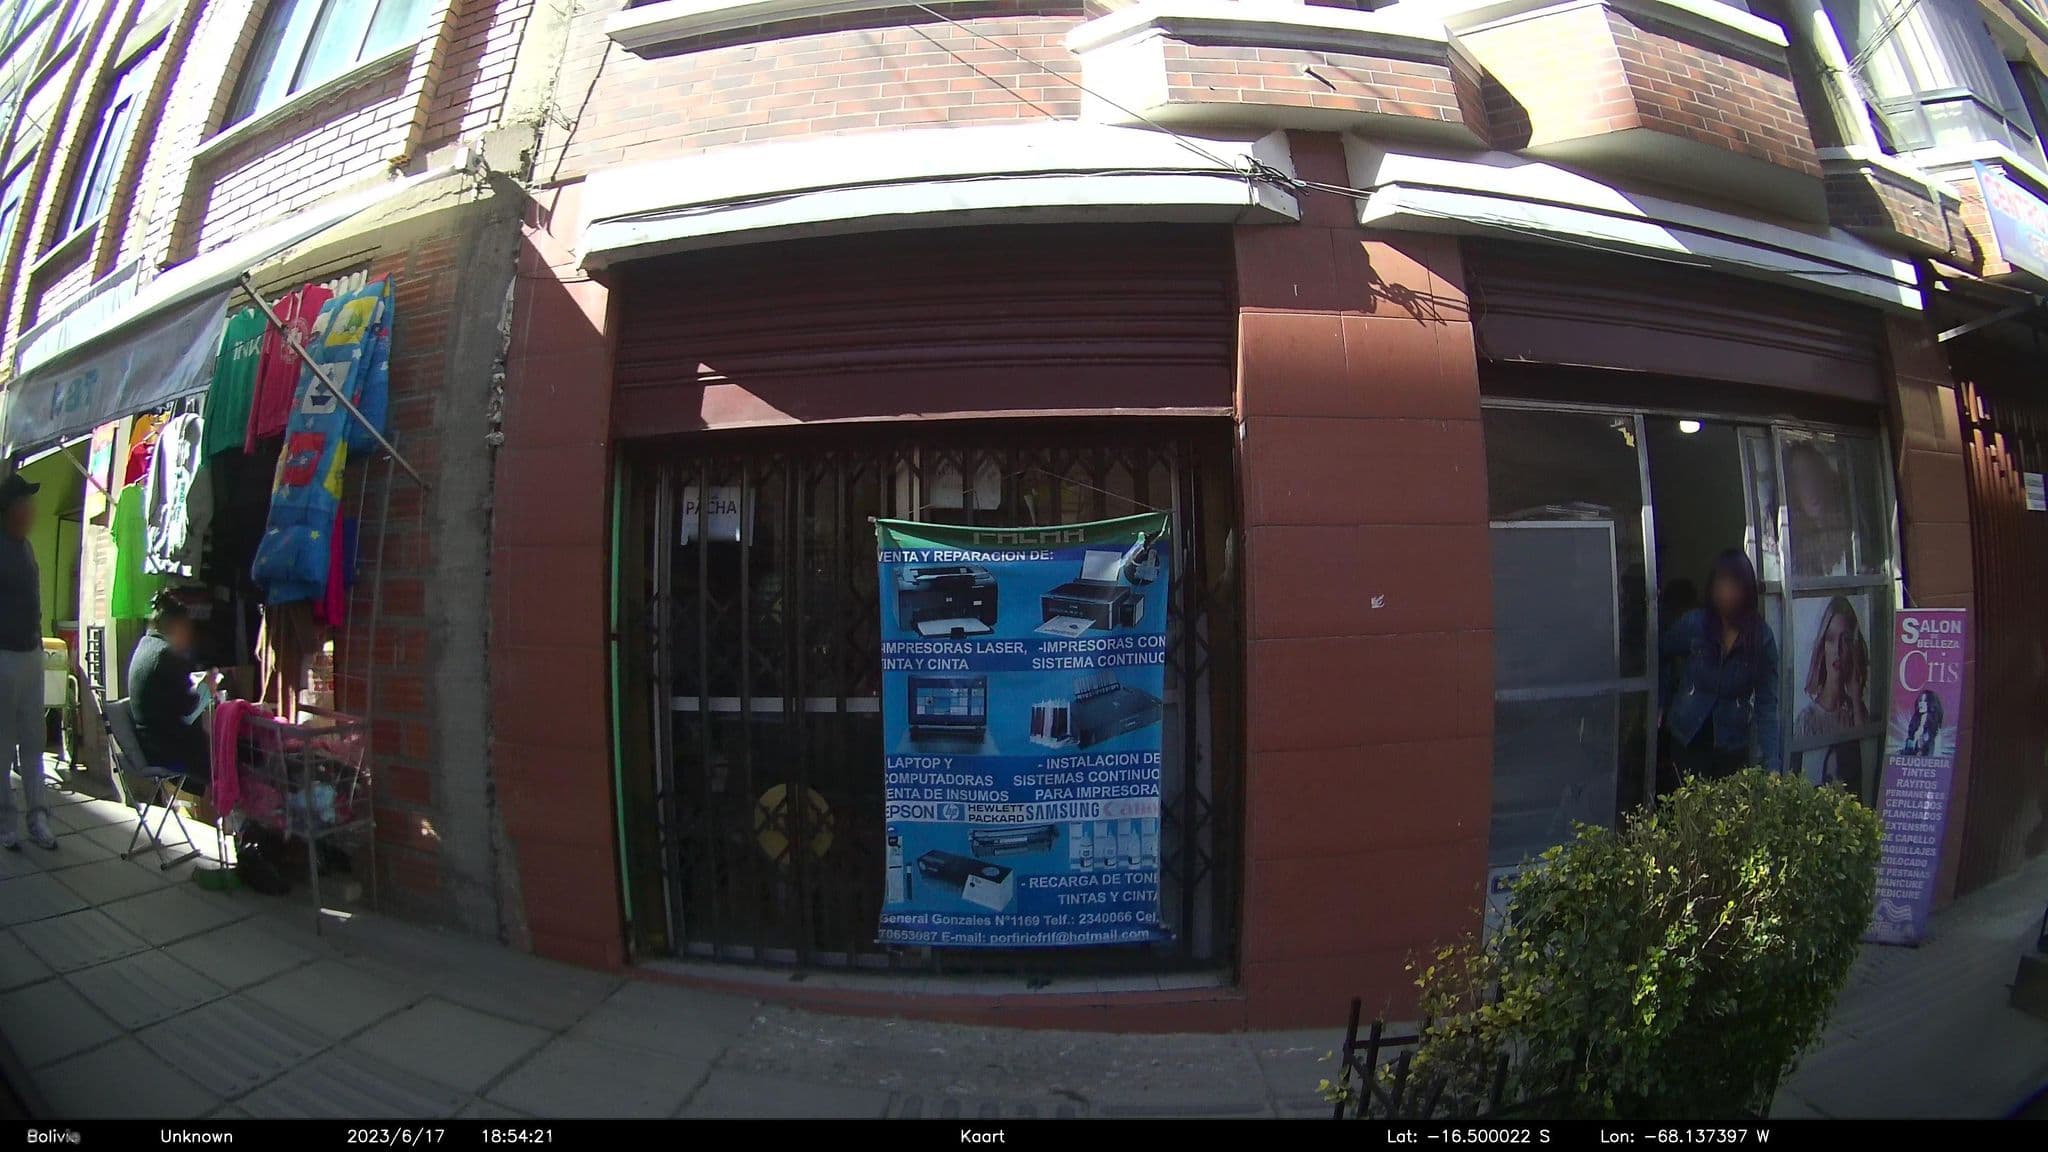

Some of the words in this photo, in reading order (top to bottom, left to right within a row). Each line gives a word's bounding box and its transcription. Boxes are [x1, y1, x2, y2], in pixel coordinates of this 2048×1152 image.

[919, 550, 931, 562] Y
[1030, 549, 1054, 561] DE:
[1901, 617, 1961, 644] SALON
[976, 641, 1028, 655] LASER,
[1038, 637, 1134, 653] -IMPRESORAS
[915, 658, 925, 670] Y
[927, 658, 969, 670] CINTA
[1032, 656, 1094, 669] SISTEMA
[1900, 650, 1959, 692] Cris
[887, 757, 941, 769] LAPTOP
[943, 758, 953, 769] Y
[1046, 754, 1139, 769] INSTALACION
[1143, 752, 1160, 764] DE
[1889, 756, 1950, 768] PELUQUERIA
[1013, 771, 1085, 786] SISTEMAS
[1902, 767, 1937, 778] TINTES
[1896, 779, 1937, 790] RAYITOS
[924, 788, 943, 799] DE
[946, 789, 1009, 802] INSUMOS
[1035, 788, 1073, 800] PARA
[1076, 784, 1159, 798] IMPRESORA
[968, 804, 1024, 813] HEWLETT
[1886, 799, 1943, 810] CEPILLADOS
[1026, 802, 1099, 821] SAMSUNG
[1882, 809, 1942, 820] PLANCHADOS
[968, 814, 1025, 823] PACKARD
[1884, 822, 1935, 832] EXTENSION
[1029, 876, 1098, 888] RECARGA
[1102, 874, 1121, 885] DE
[1058, 892, 1106, 905] TINTAS
[1110, 891, 1119, 902] Y
[932, 913, 991, 926] Gonzales
[942, 931, 986, 944] E-mail:
